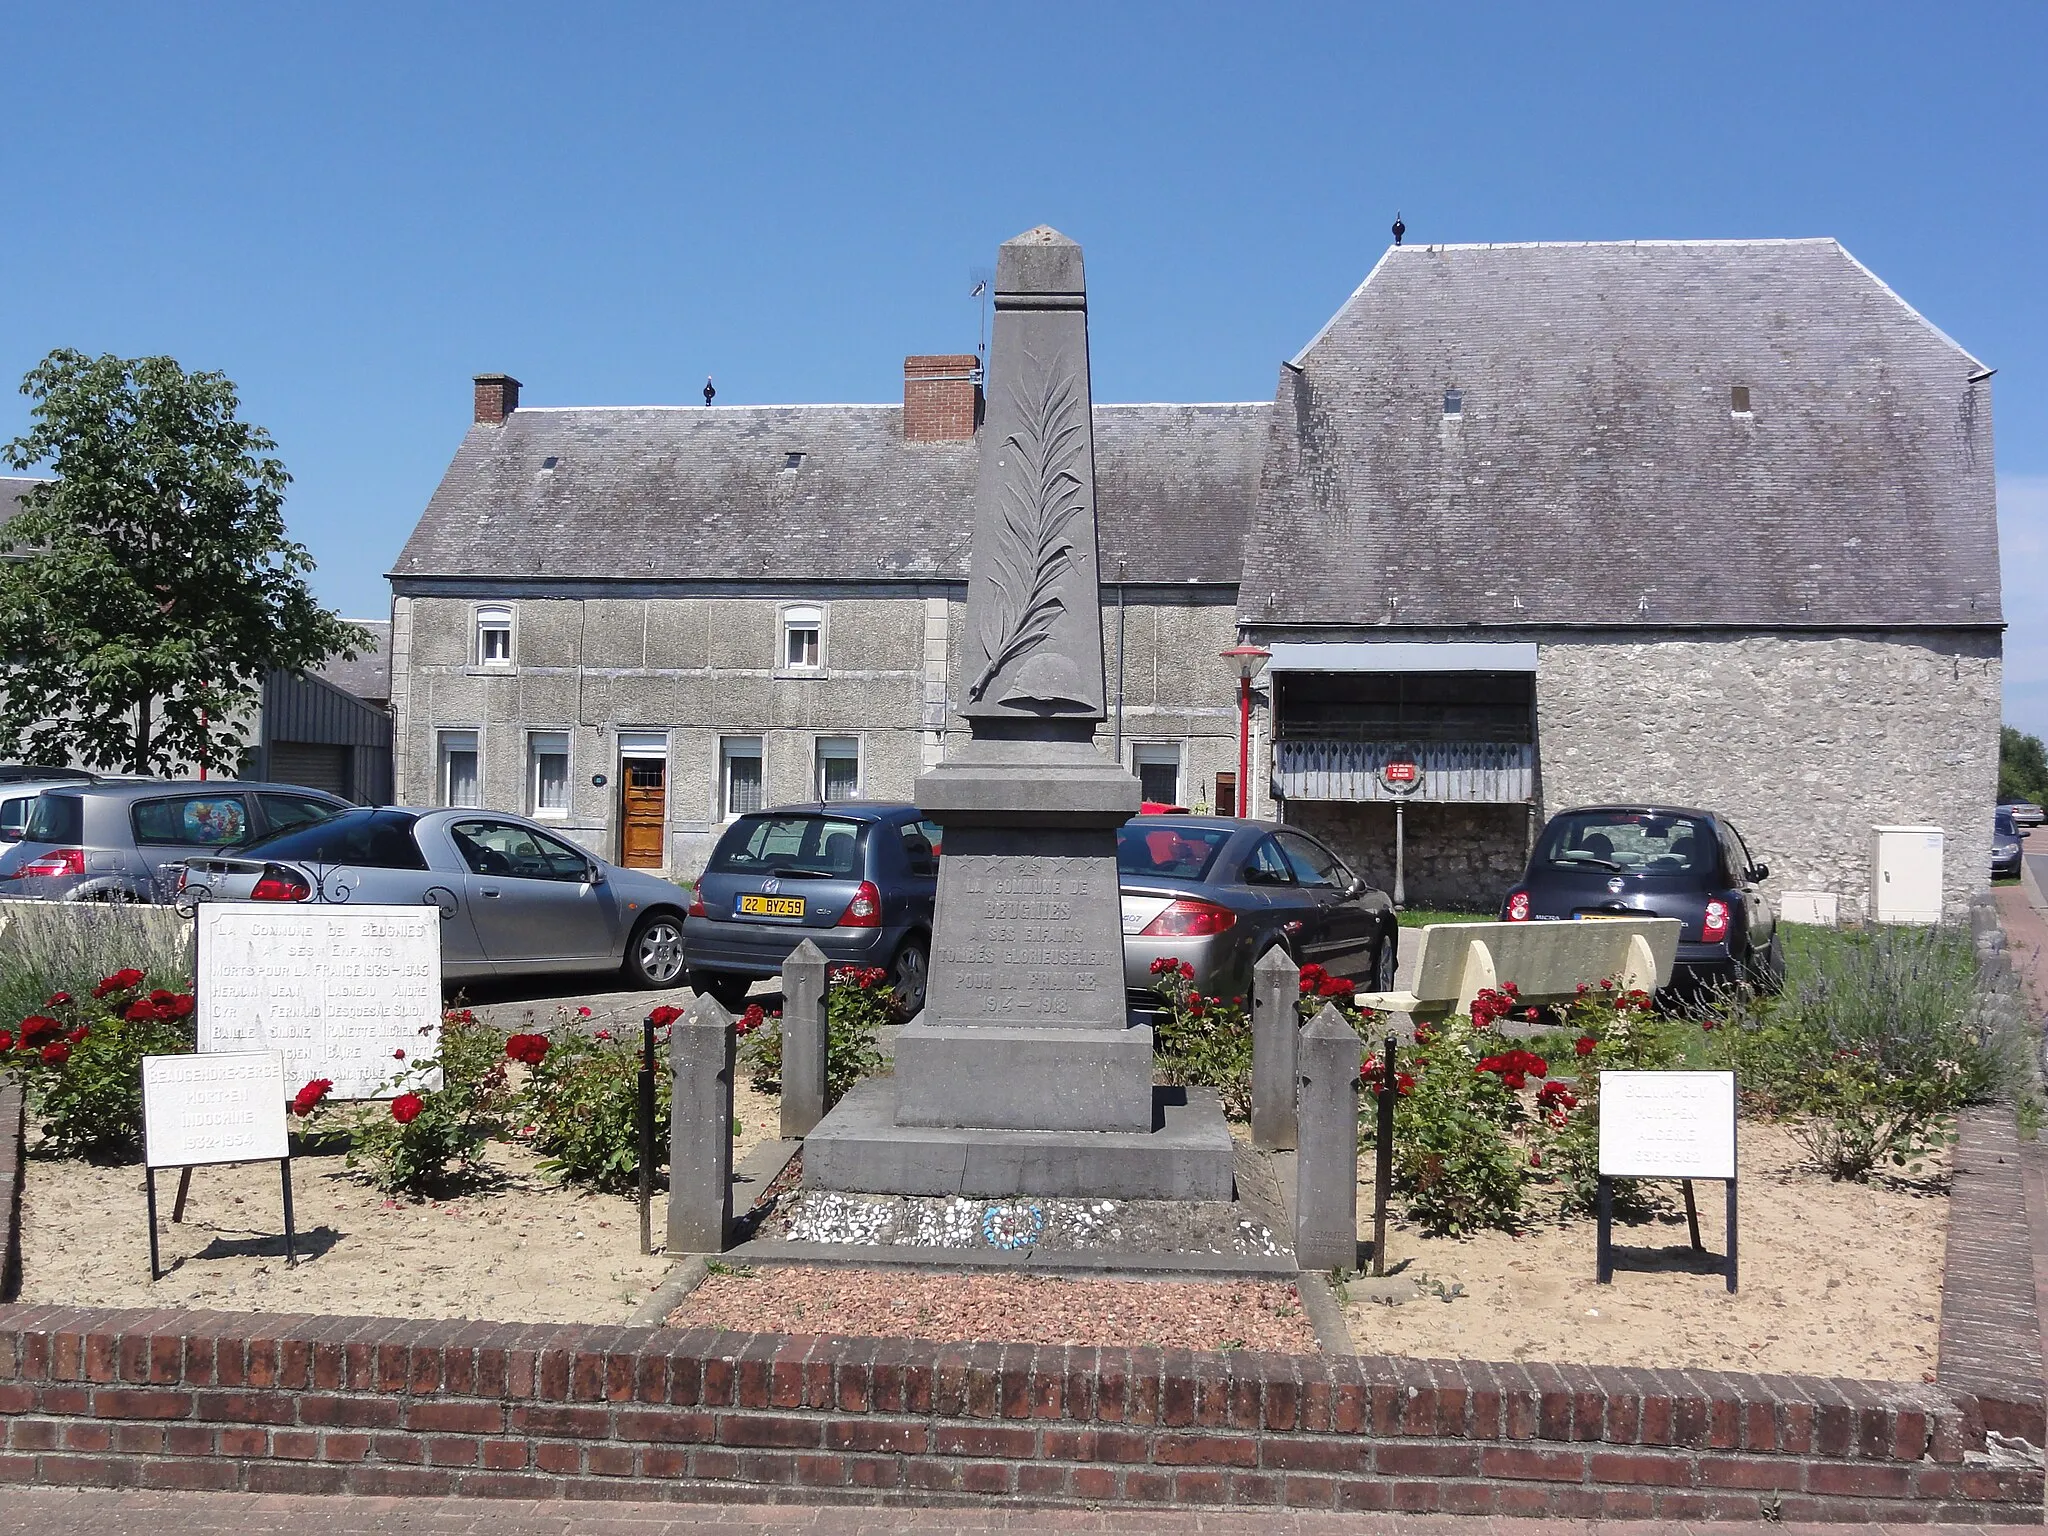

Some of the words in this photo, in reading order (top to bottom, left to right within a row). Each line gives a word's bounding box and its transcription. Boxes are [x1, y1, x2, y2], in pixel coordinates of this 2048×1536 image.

[966, 880, 984, 895] LA
[994, 879, 1060, 895] COMMUNE
[1071, 881, 1088, 896] DE
[745, 898, 758, 911] 22
[766, 899, 785, 913] BYZ
[787, 901, 801, 914] 59
[984, 901, 1072, 920] BEUGNIES
[218, 925, 236, 936] LA
[251, 924, 313, 937] COMMUNE
[328, 925, 346, 937] DE
[361, 924, 425, 937] BEUGNIES
[988, 926, 1016, 942] SES
[1024, 926, 1085, 943] ENFANTS
[288, 947, 315, 957] SES
[332, 946, 393, 957] ENFANTS
[939, 945, 995, 963] TOMBÉS
[1003, 949, 1114, 966] GLORIEUSEMENT
[213, 965, 255, 977] MORTS
[257, 965, 290, 977] POUR
[294, 965, 313, 977] LA
[314, 964, 361, 977] FRANCE
[955, 973, 992, 989] POUR
[1000, 973, 1018, 990] LA
[1027, 972, 1097, 991] FRANCE
[271, 986, 301, 997] JEAN
[213, 1005, 237, 1017] CYR
[270, 1005, 321, 1017] FERNAND
[393, 1005, 425, 1017] SIMON
